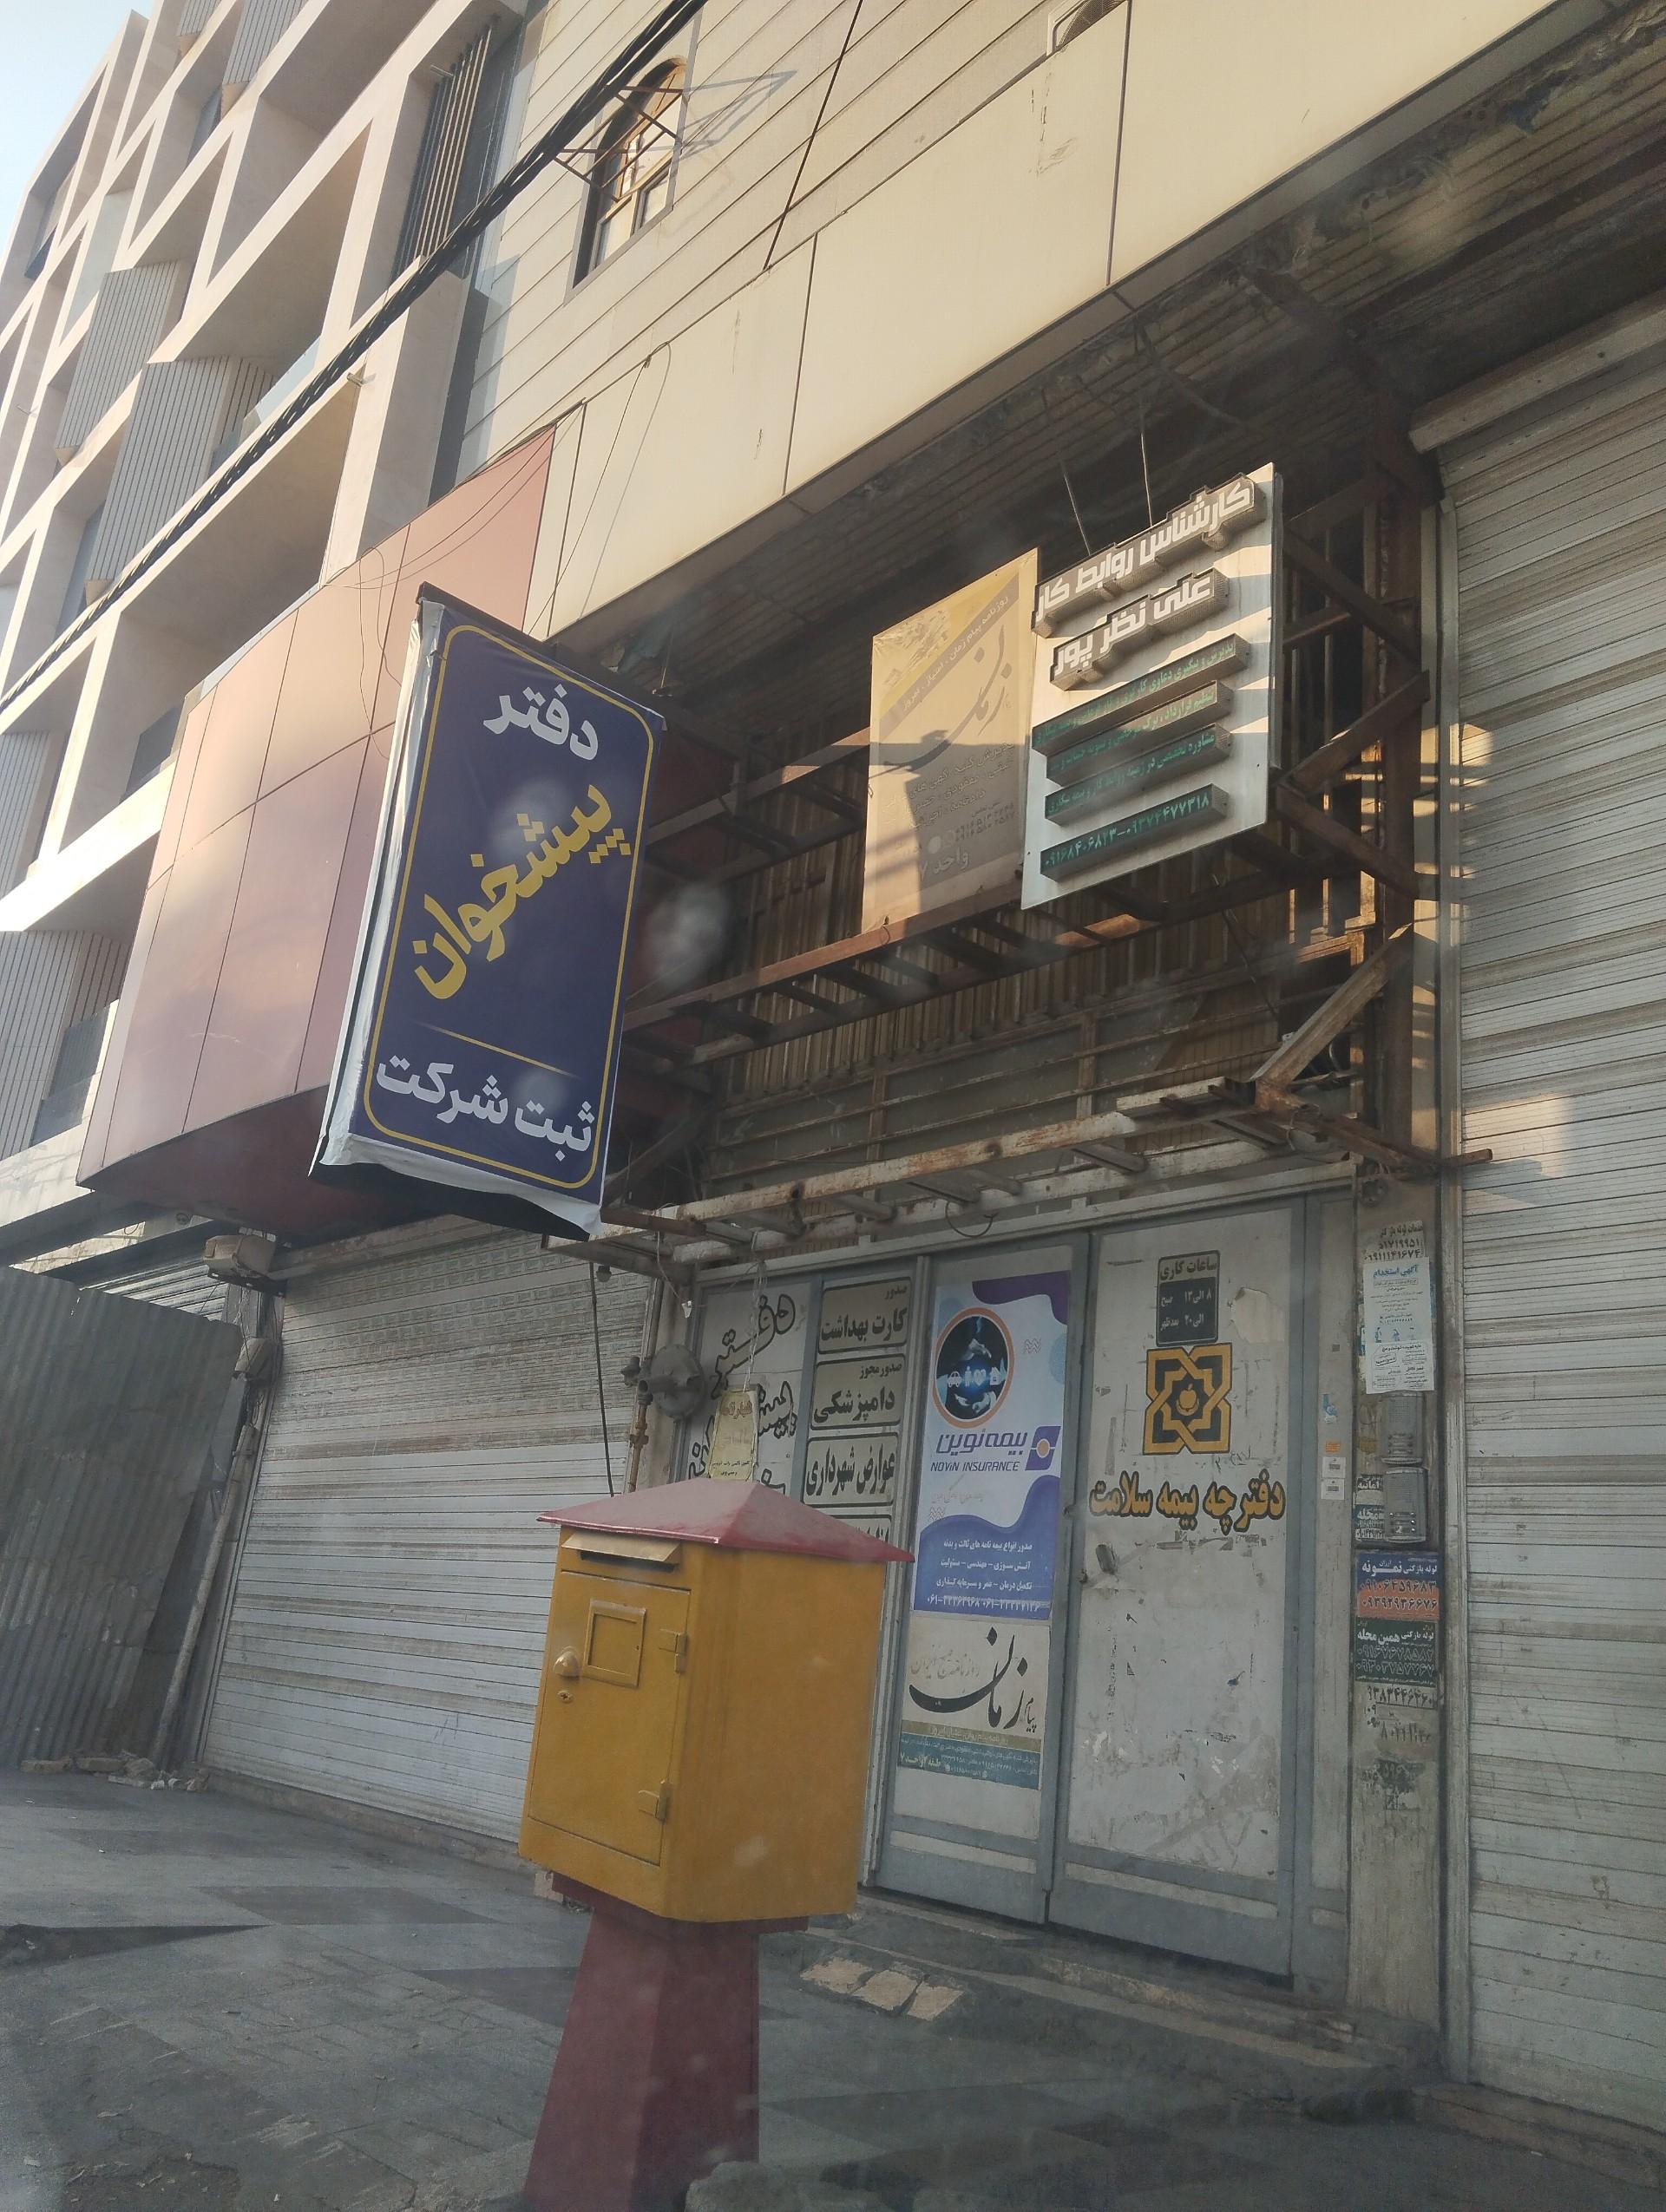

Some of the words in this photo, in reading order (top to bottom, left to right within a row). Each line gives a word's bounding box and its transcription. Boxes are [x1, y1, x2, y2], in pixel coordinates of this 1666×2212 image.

[1140, 482, 1250, 566] کارشناس
[1076, 547, 1133, 594] روابط
[1036, 579, 1069, 623] کار
[1154, 577, 1210, 619] علی
[1100, 601, 1145, 652] نظر
[1054, 633, 1092, 676] پور
[483, 684, 599, 761] دفتر
[414, 784, 631, 999] پیشخوان
[376, 1053, 508, 1125] شرکت
[514, 1094, 594, 1160] ثبت
[1160, 1260, 1184, 1280] کاری
[1187, 1256, 1217, 1273] ساعات
[1374, 1267, 1399, 1278] استخدام
[885, 1285, 907, 1299] صدور
[821, 1313, 869, 1342] بهداشت
[872, 1308, 907, 1341] کارت
[860, 1365, 879, 1379] مجوز
[880, 1363, 902, 1377] صدور
[814, 1386, 895, 1423] دامپزشکی
[936, 1429, 986, 1456] نوین
[985, 1432, 1027, 1456] بیمه
[806, 1443, 855, 1495] شهرداری
[856, 1443, 895, 1494] عوارض
[962, 1461, 1020, 1472] INSURANCE
[1090, 1470, 1153, 1516] سلامت
[1156, 1481, 1198, 1530] بیمه
[959, 1538, 970, 1548] ثالث
[970, 1540, 981, 1550] های
[981, 1540, 992, 1548] نامه
[993, 1541, 1004, 1550] بیمه
[1004, 1542, 1017, 1553] انواع
[1018, 1543, 1033, 1553] صدور
[967, 1561, 987, 1569] مهندسی
[994, 1561, 1013, 1572] سوزی
[1013, 1561, 1031, 1572] آتش
[1361, 1560, 1402, 1577] نمونه
[1425, 1565, 1437, 1574] لوله
[957, 1578, 977, 1588] سرمایه
[1000, 1580, 1015, 1592] درمان
[1017, 1581, 1033, 1592] تکمیل
[1357, 1628, 1377, 1641] محله
[1378, 1633, 1400, 1646] همین
[1423, 1632, 1434, 1641] لوله
[909, 1626, 1028, 1729] زمان
